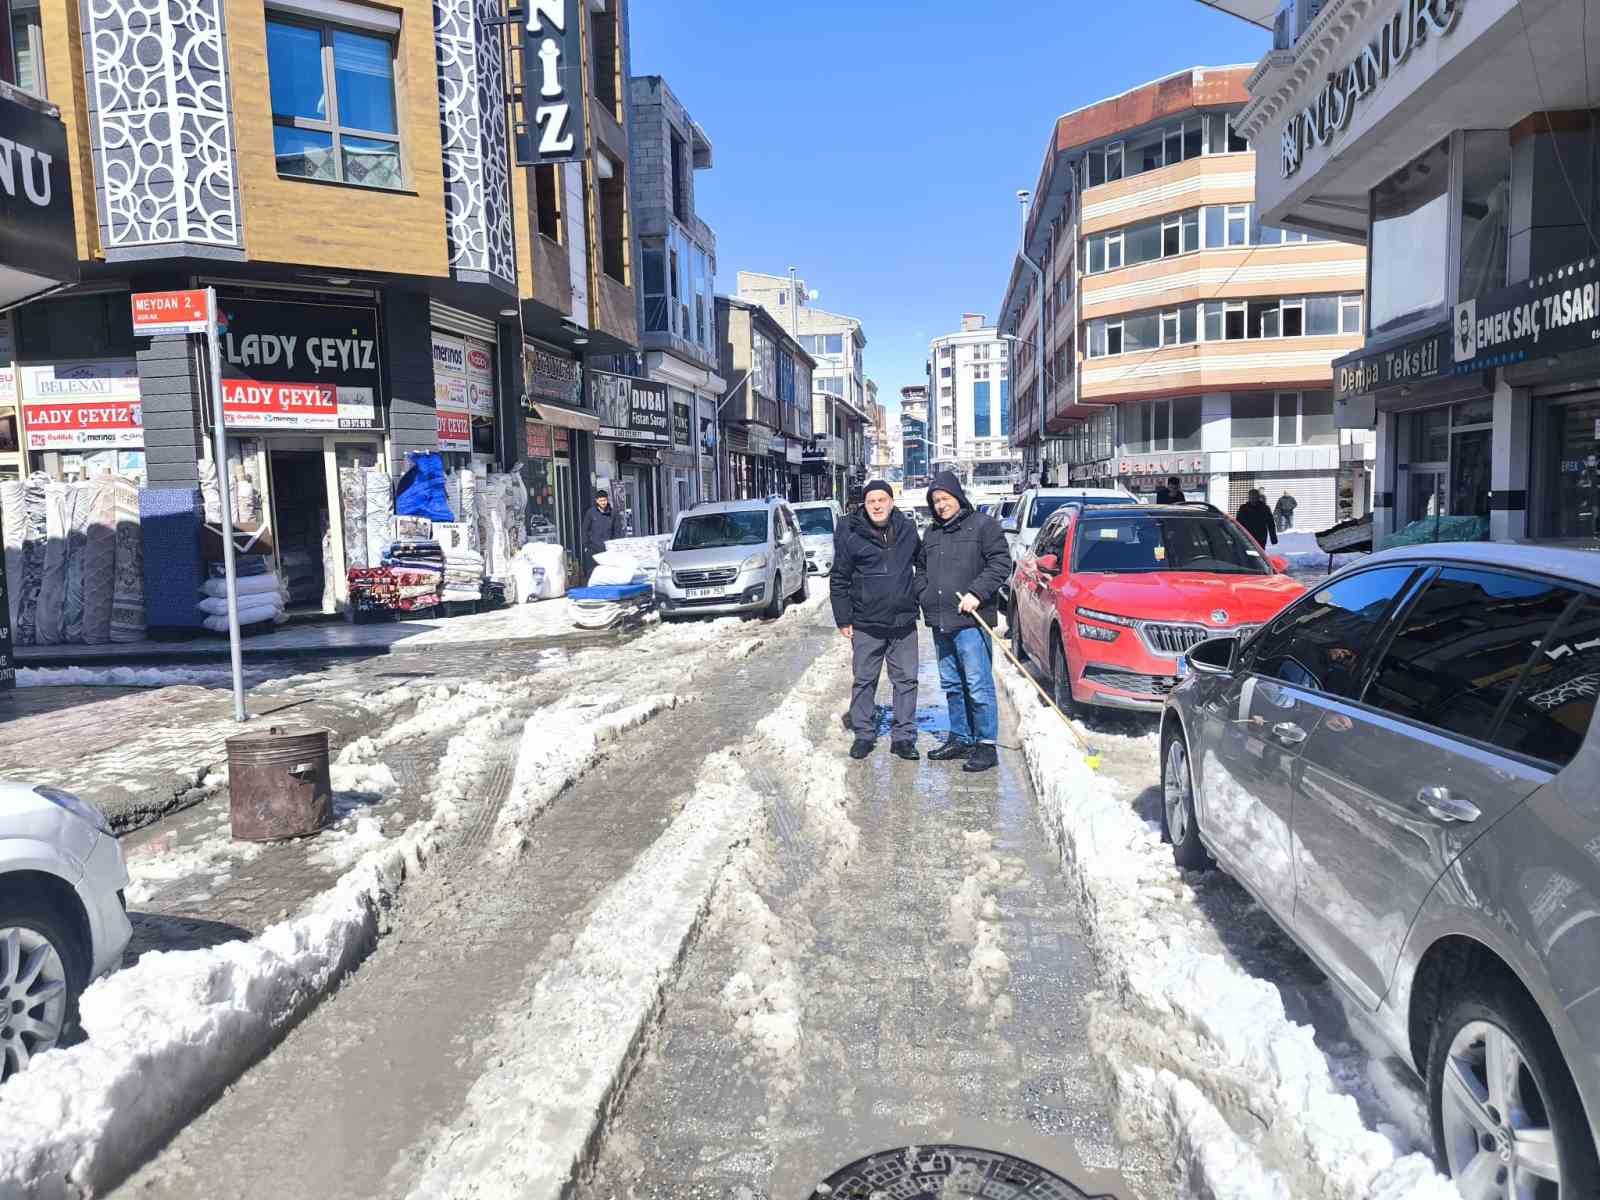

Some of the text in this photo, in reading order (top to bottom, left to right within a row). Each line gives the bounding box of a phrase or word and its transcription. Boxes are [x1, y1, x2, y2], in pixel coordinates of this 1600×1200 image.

[136, 296, 192, 311] MEYDAN 2
[1477, 311, 1512, 349] EMEK
[1513, 300, 1540, 343] SAÇ
[226, 328, 376, 375] LADY ÇEYİZ
[433, 344, 463, 366] merinos
[1385, 340, 1439, 381] Tekstil
[40, 379, 106, 393] BELENAY
[222, 385, 332, 410] LADY ÇEYİZ
[26, 404, 128, 427] LADY ÇEYİZ
